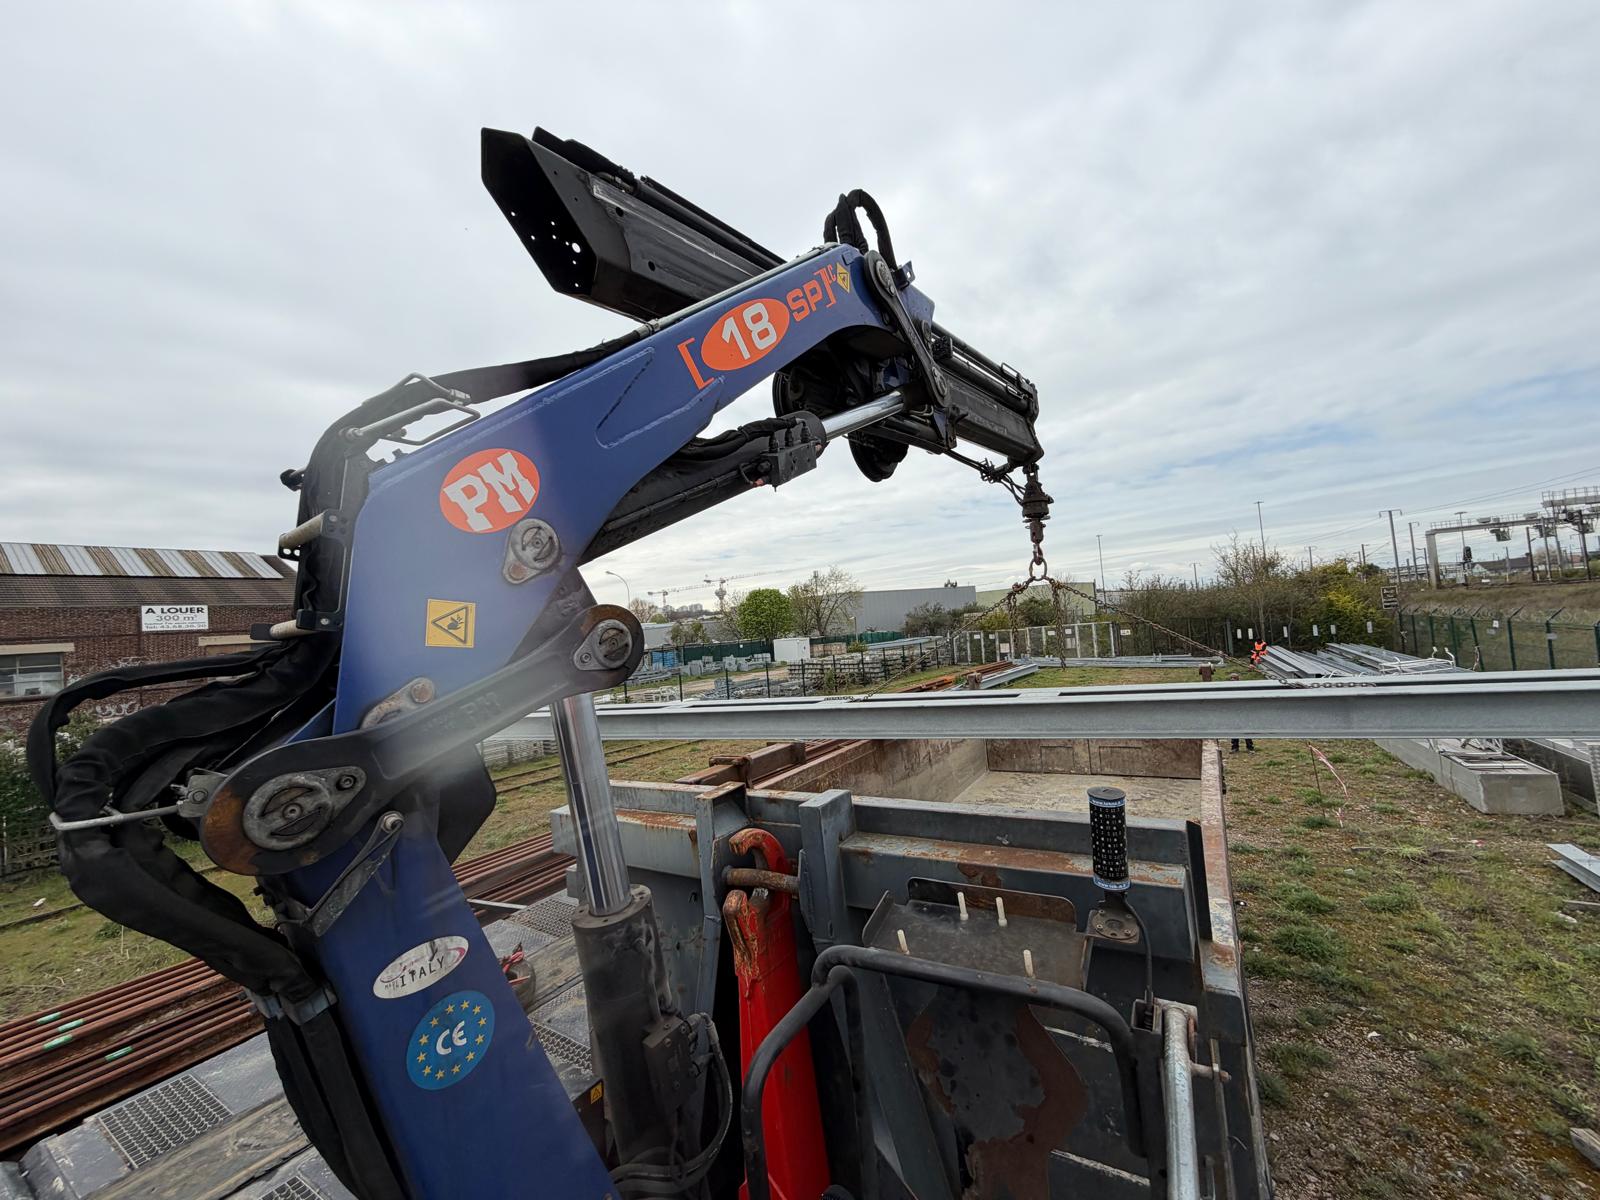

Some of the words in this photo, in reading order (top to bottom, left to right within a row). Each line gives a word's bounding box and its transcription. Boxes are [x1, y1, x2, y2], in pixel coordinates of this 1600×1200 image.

[443, 451, 536, 531] PM
[160, 606, 205, 614] LOUER
[400, 956, 444, 988] ITALY
[436, 1020, 467, 1055] CE
